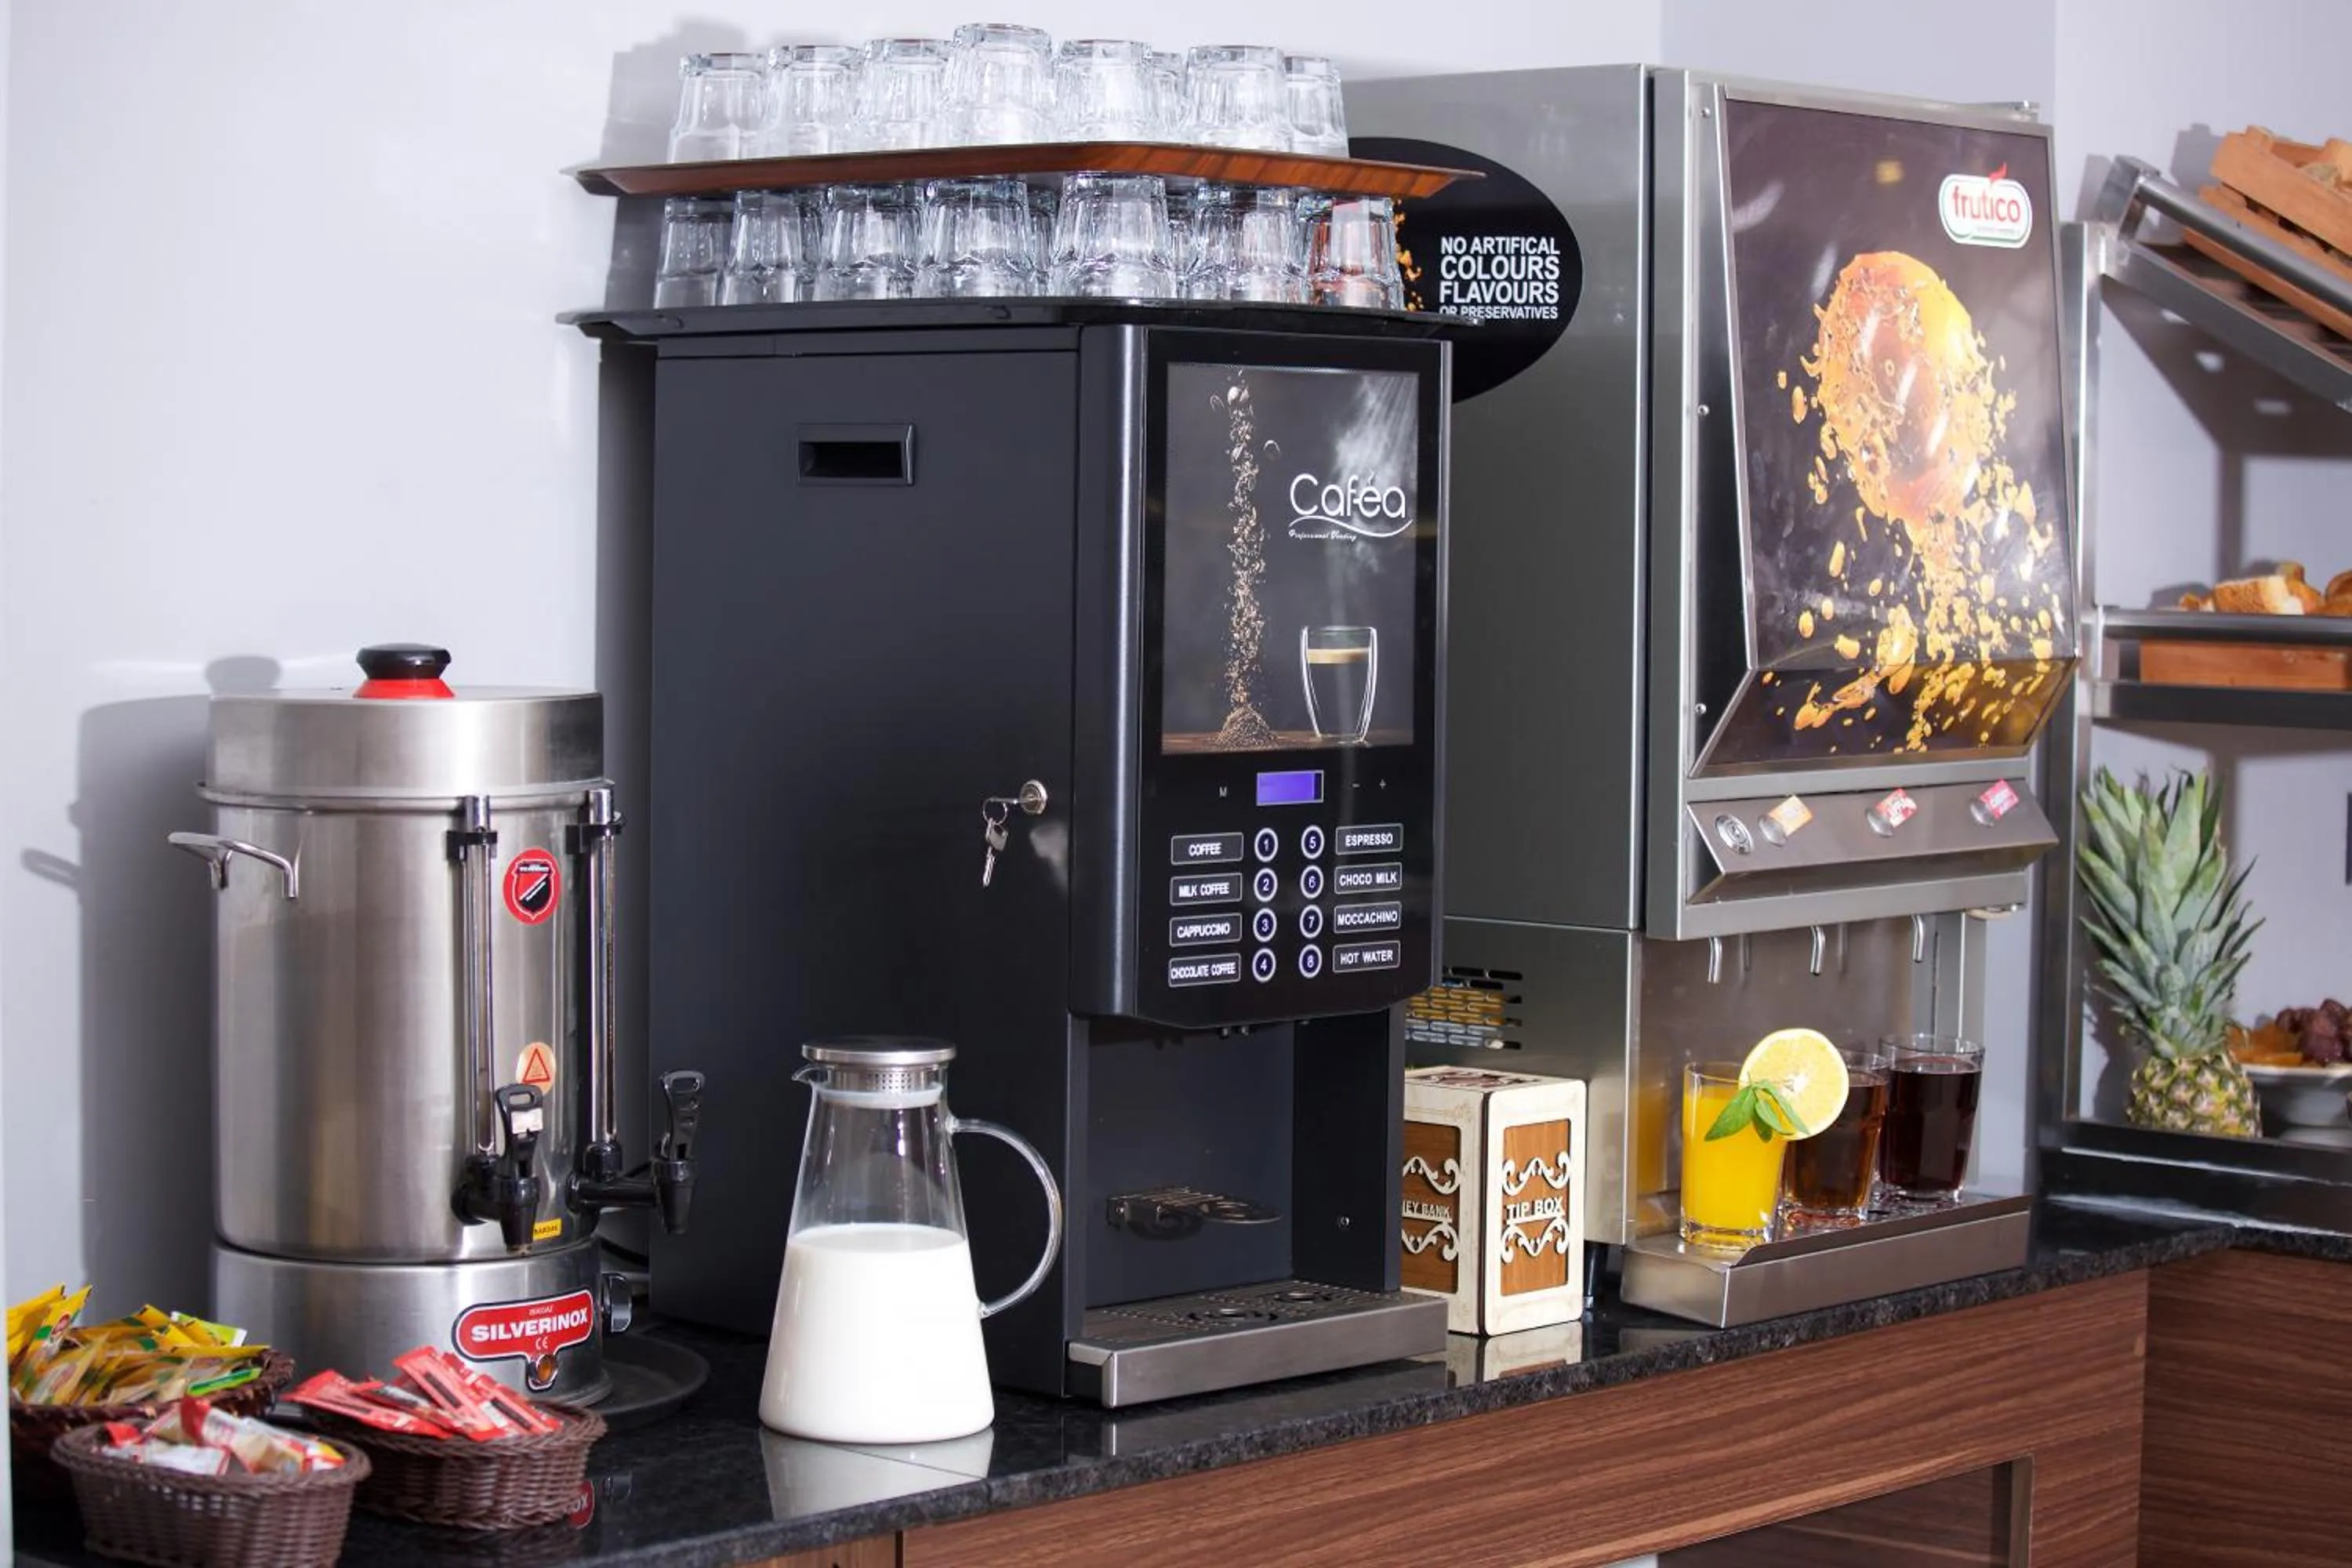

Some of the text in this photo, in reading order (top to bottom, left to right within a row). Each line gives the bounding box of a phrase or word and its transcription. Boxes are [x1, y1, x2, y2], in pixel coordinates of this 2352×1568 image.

[1952, 184, 2021, 223] frutico
[1441, 237, 1560, 255] NO ARTIFICAL
[1440, 255, 1560, 280] COLOURS
[1439, 281, 1559, 304] FLAVOURS
[1439, 305, 1559, 319] OR PRESERVATIVES
[1264, 838, 1269, 852] 1
[1308, 836, 1316, 849] 5
[1345, 833, 1393, 847] ESPRESSO
[1189, 842, 1222, 856] COFFEE
[1262, 877, 1269, 891] 2
[1308, 876, 1316, 889] 6
[1339, 871, 1397, 887] CHOCO MILK
[1178, 882, 1230, 898] MILK COFFEE
[1261, 918, 1269, 932] 3
[1308, 915, 1316, 929] 7
[1338, 910, 1398, 926] MOCCACHINO
[1177, 923, 1230, 938] CAPPUCCINO
[1260, 958, 1268, 972] 4
[1306, 955, 1314, 970] 8
[1340, 949, 1393, 966] HOT WATER
[1171, 962, 1236, 979] CHOCOLATE COFFEE
[1505, 1196, 1566, 1220] TIP BOX
[471, 1307, 587, 1343] SILVERINOX
